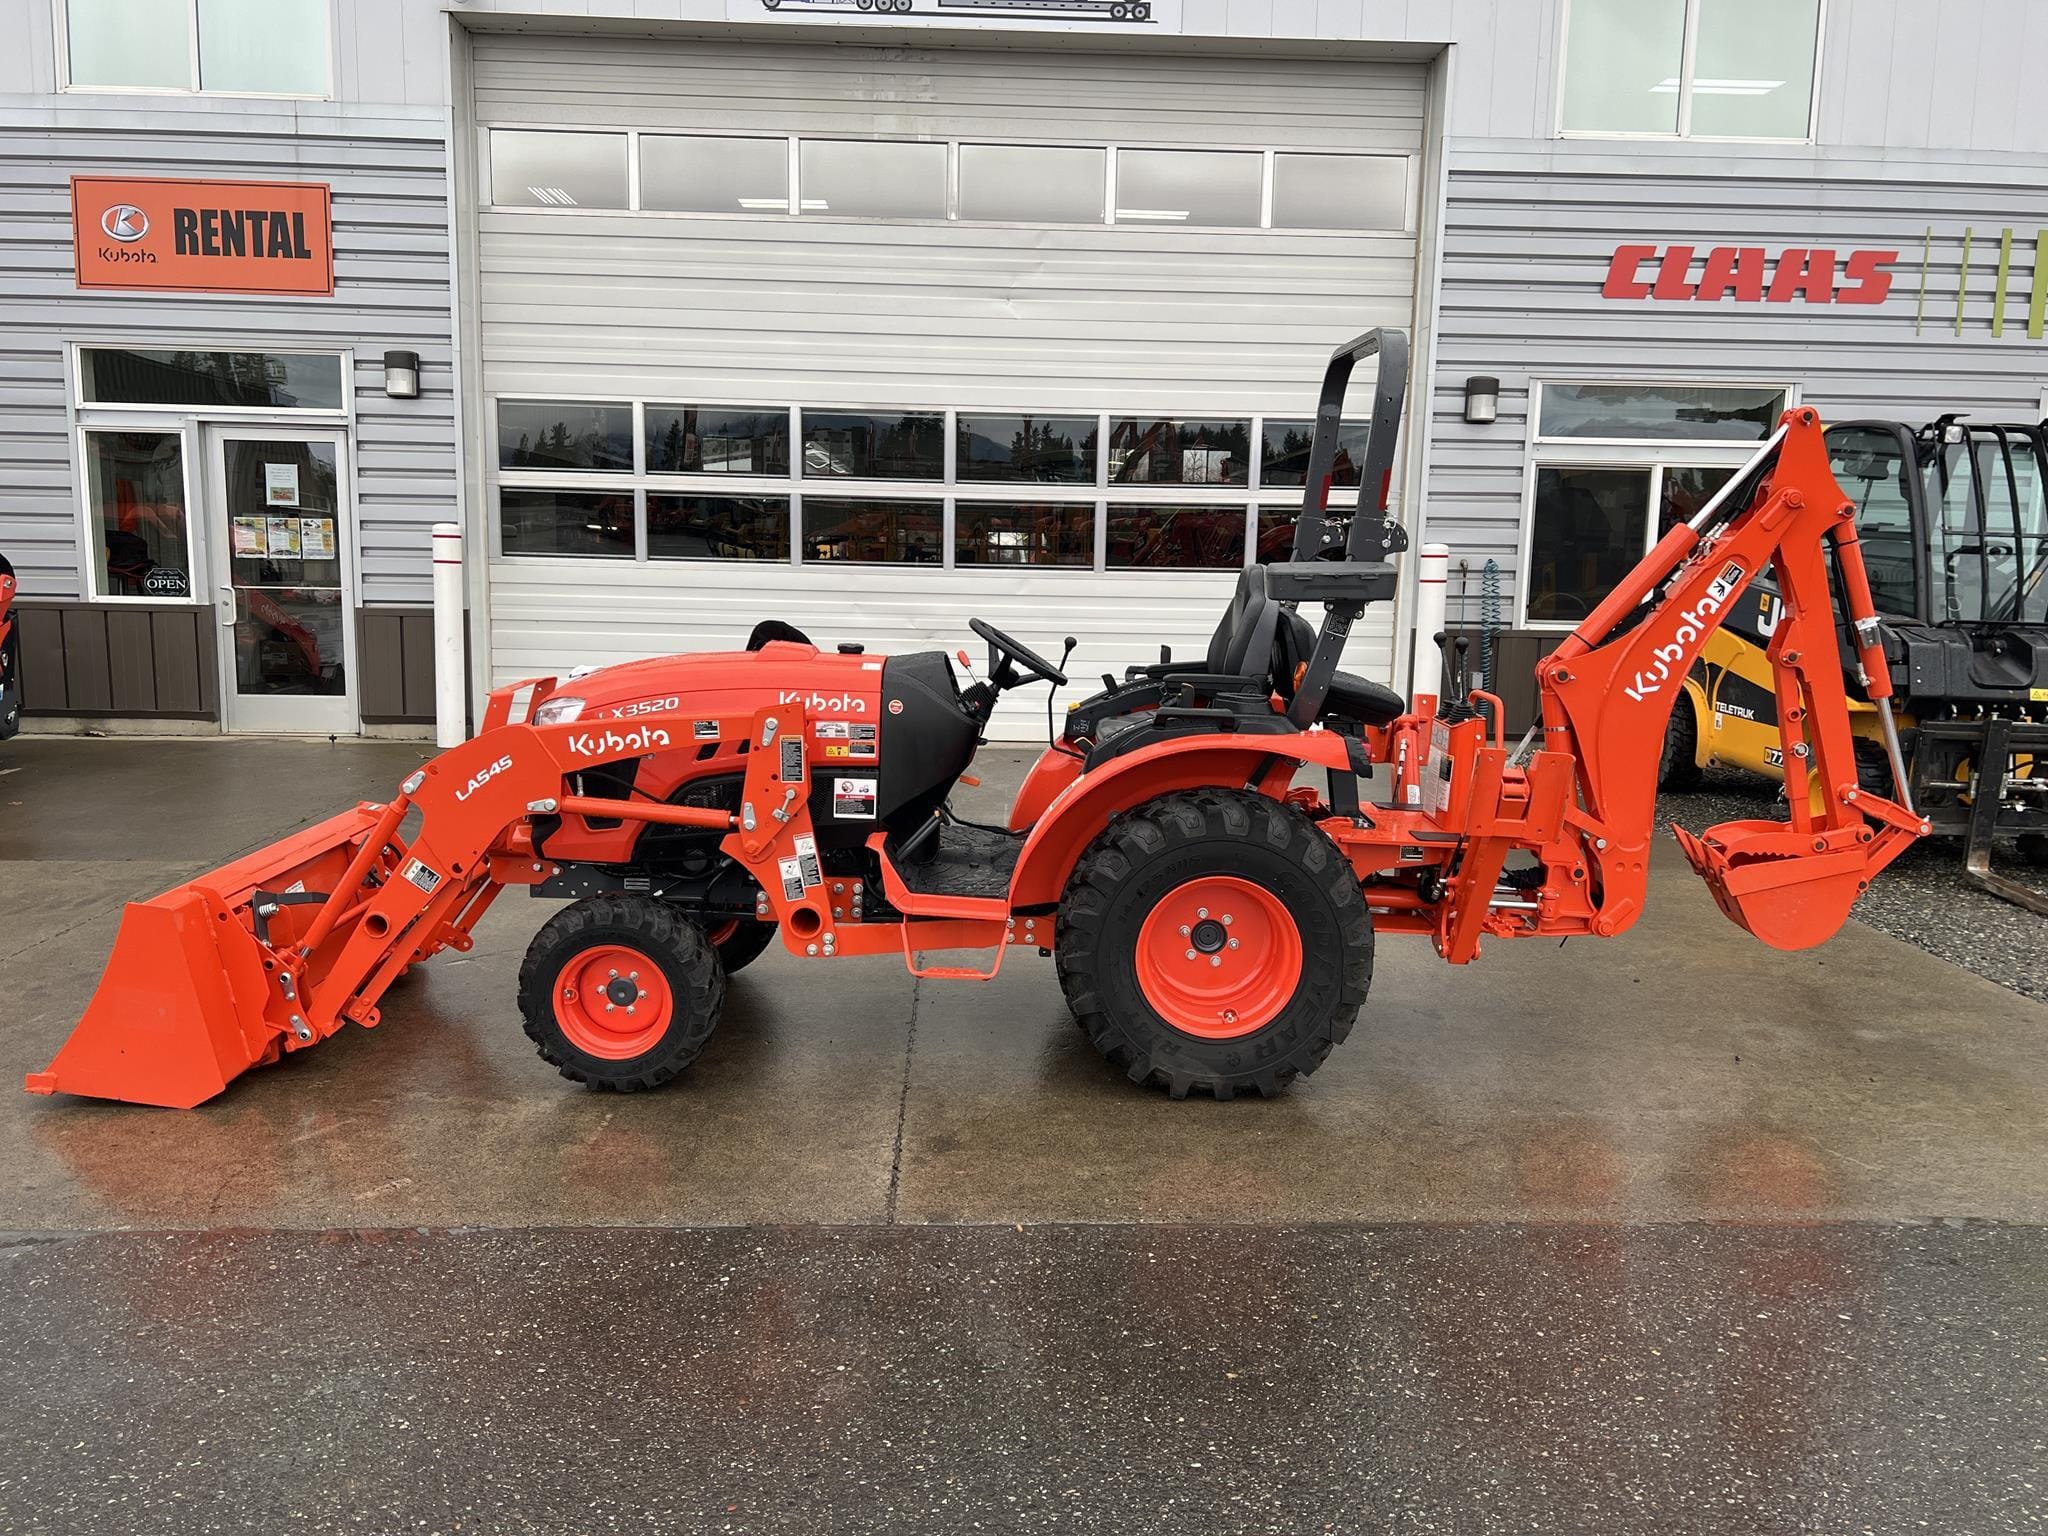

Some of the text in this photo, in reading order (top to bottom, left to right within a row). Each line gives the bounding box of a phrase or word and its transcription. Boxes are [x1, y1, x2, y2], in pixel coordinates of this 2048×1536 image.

[173, 208, 312, 259] RENTAL
[98, 247, 158, 265] Kubota
[1601, 244, 1900, 304] CLAAS
[146, 579, 187, 589] OPEN
[1757, 597, 1786, 637] J
[1623, 597, 1721, 702] Kubota
[779, 691, 866, 713] Kubota
[1715, 701, 1755, 720] TELETRUK
[568, 725, 671, 756] Kubota
[455, 754, 513, 801] LA545
